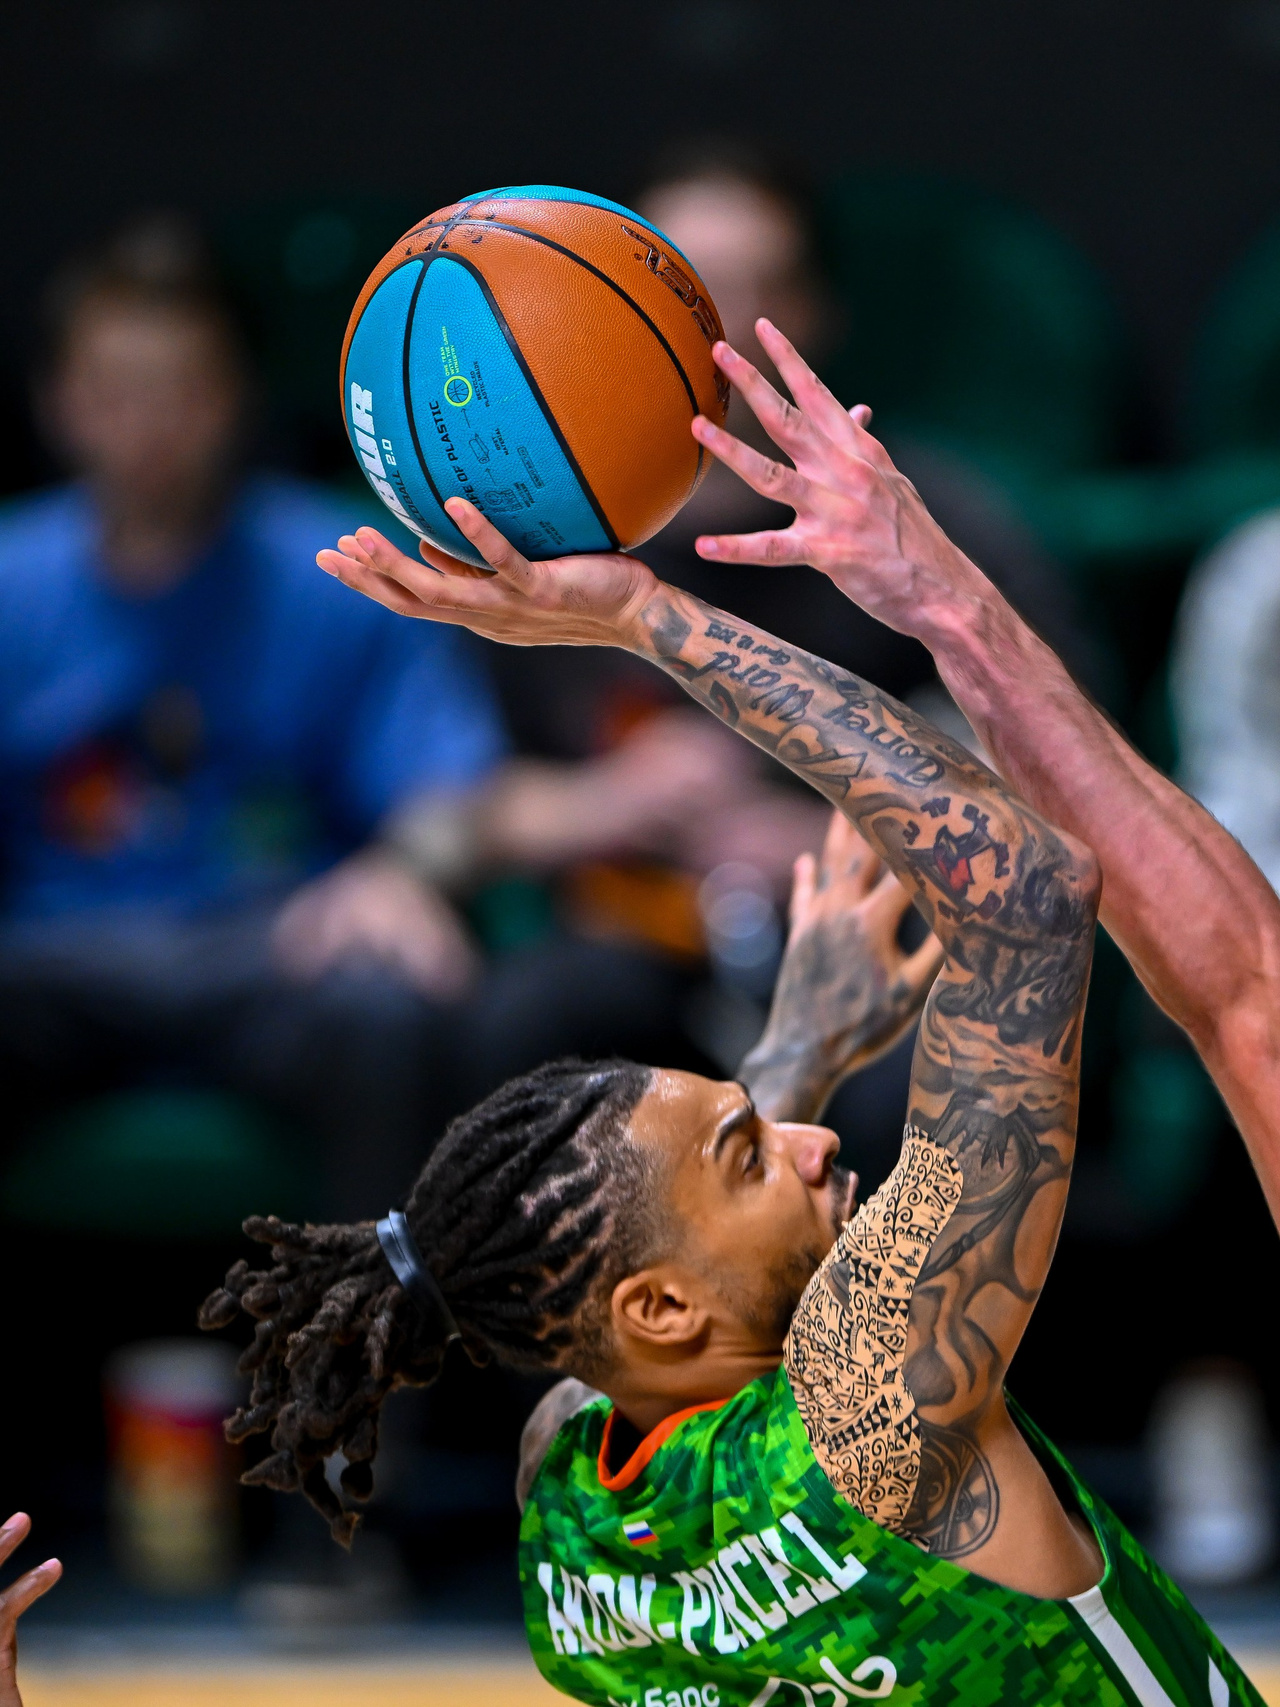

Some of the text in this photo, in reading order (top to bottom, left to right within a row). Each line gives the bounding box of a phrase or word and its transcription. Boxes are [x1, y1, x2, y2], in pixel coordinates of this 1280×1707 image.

[381, 438, 397, 466] 2.0
[429, 400, 459, 462] PLASTIC
[452, 465, 468, 482] OF
[694, 651, 815, 722] Ward
